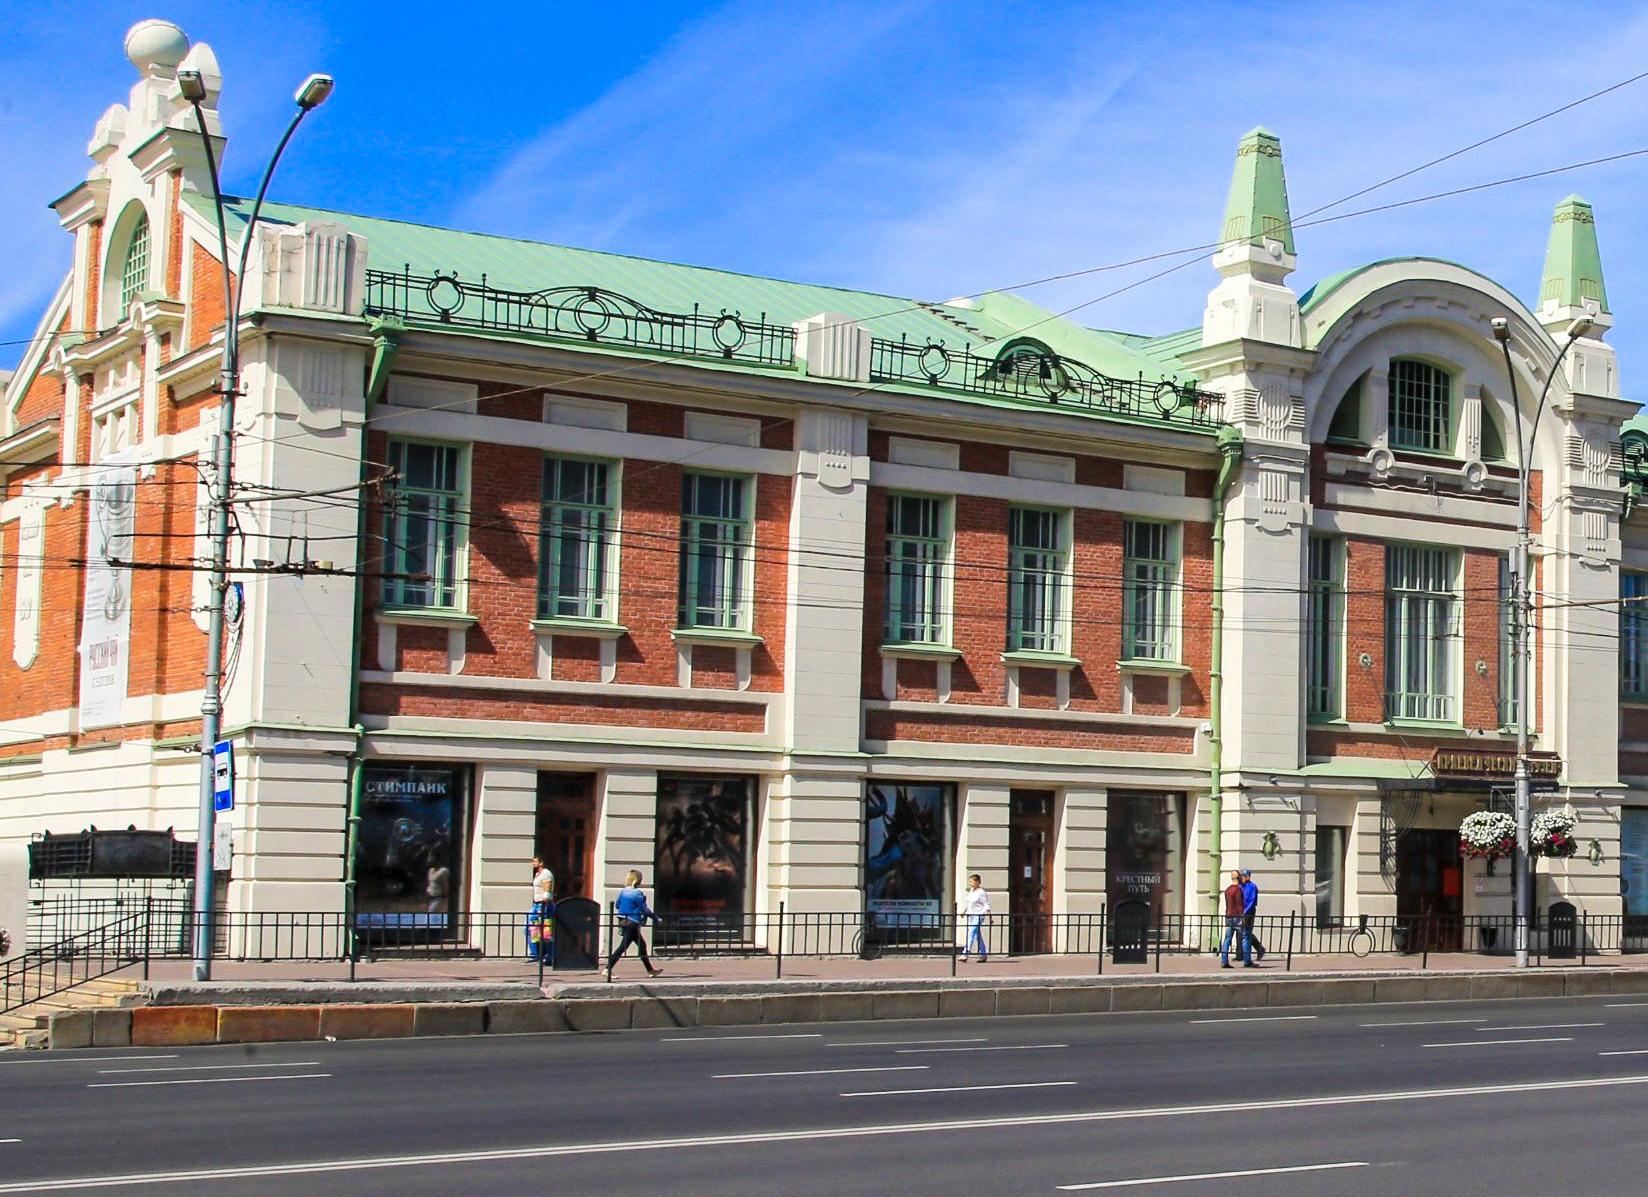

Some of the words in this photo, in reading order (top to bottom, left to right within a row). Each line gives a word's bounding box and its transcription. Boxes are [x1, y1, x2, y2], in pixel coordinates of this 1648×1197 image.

[1437, 754, 1517, 772] КРАЕВЕДЧЕСКИ
[366, 781, 447, 794] СТИМПАНК
[1116, 873, 1160, 883] КРЕСТНЫЙ
[1128, 885, 1149, 893] ПУТЬ
